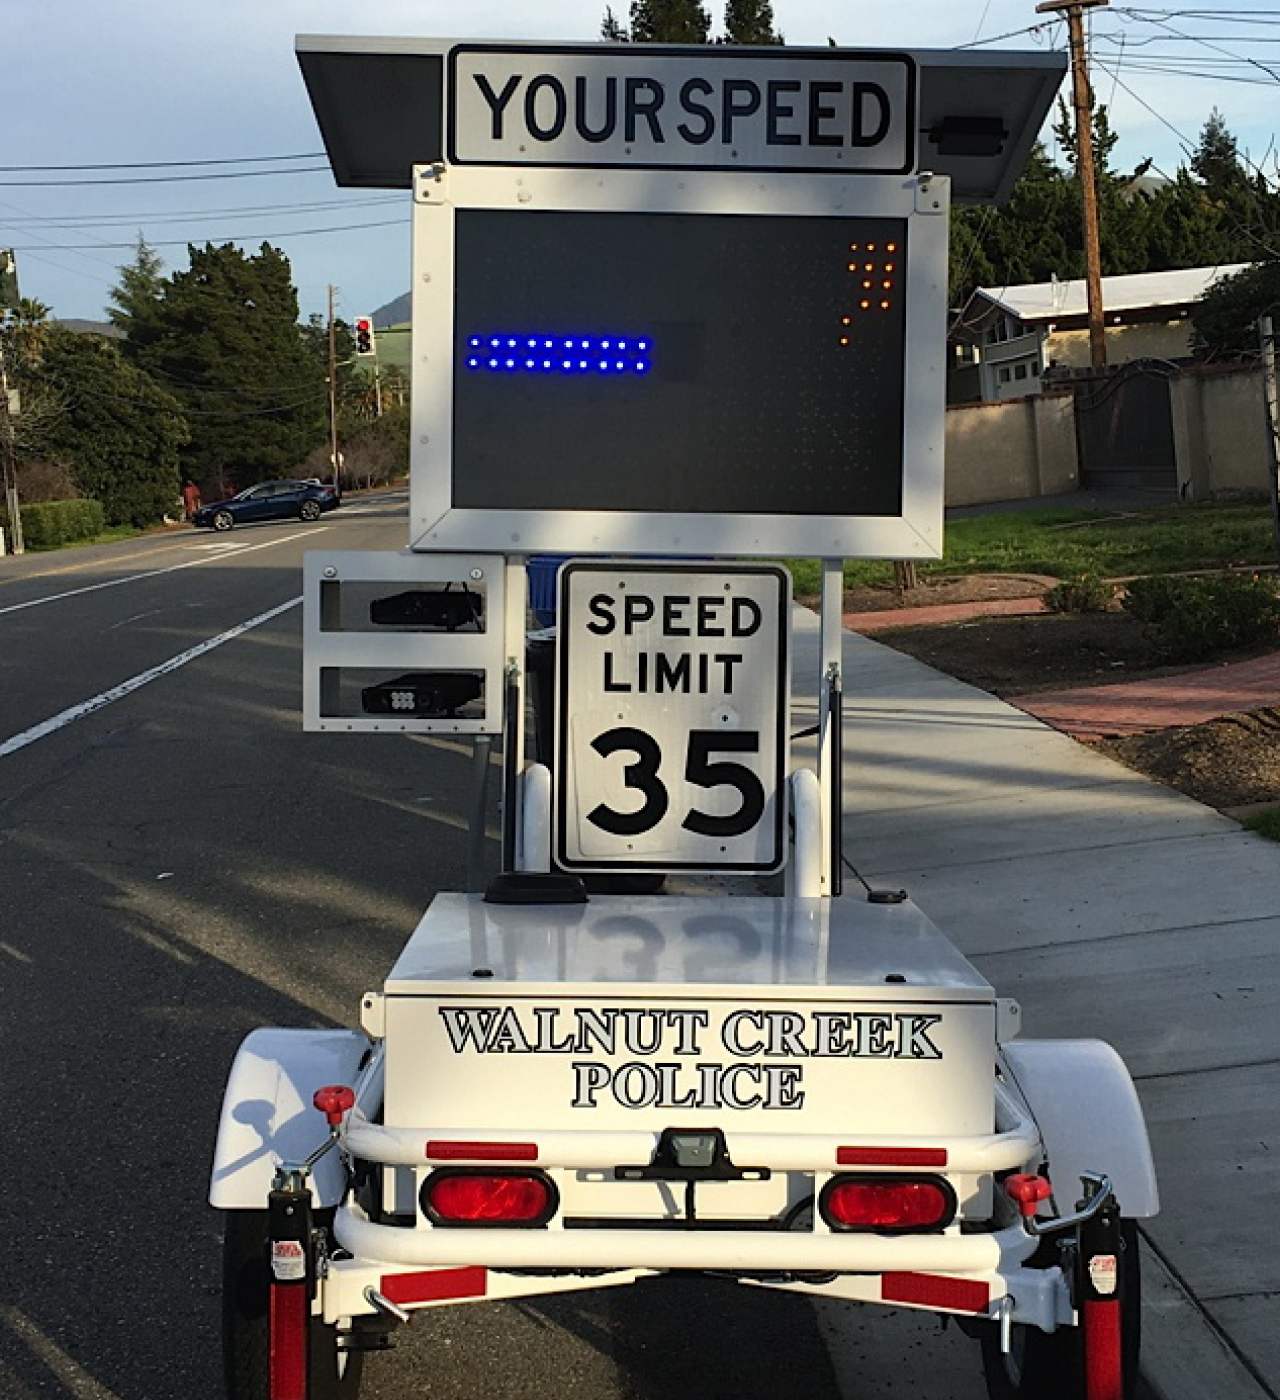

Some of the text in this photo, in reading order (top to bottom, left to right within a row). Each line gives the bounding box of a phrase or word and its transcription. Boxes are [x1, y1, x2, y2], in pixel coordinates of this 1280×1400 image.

[472, 73, 891, 148] YOUR SPEED
[586, 593, 763, 638] SPEED
[603, 651, 743, 694] LIMIT
[586, 726, 765, 838] 35
[438, 1006, 943, 1059] WALNUT CREEK
[571, 1061, 805, 1110] POLICE
